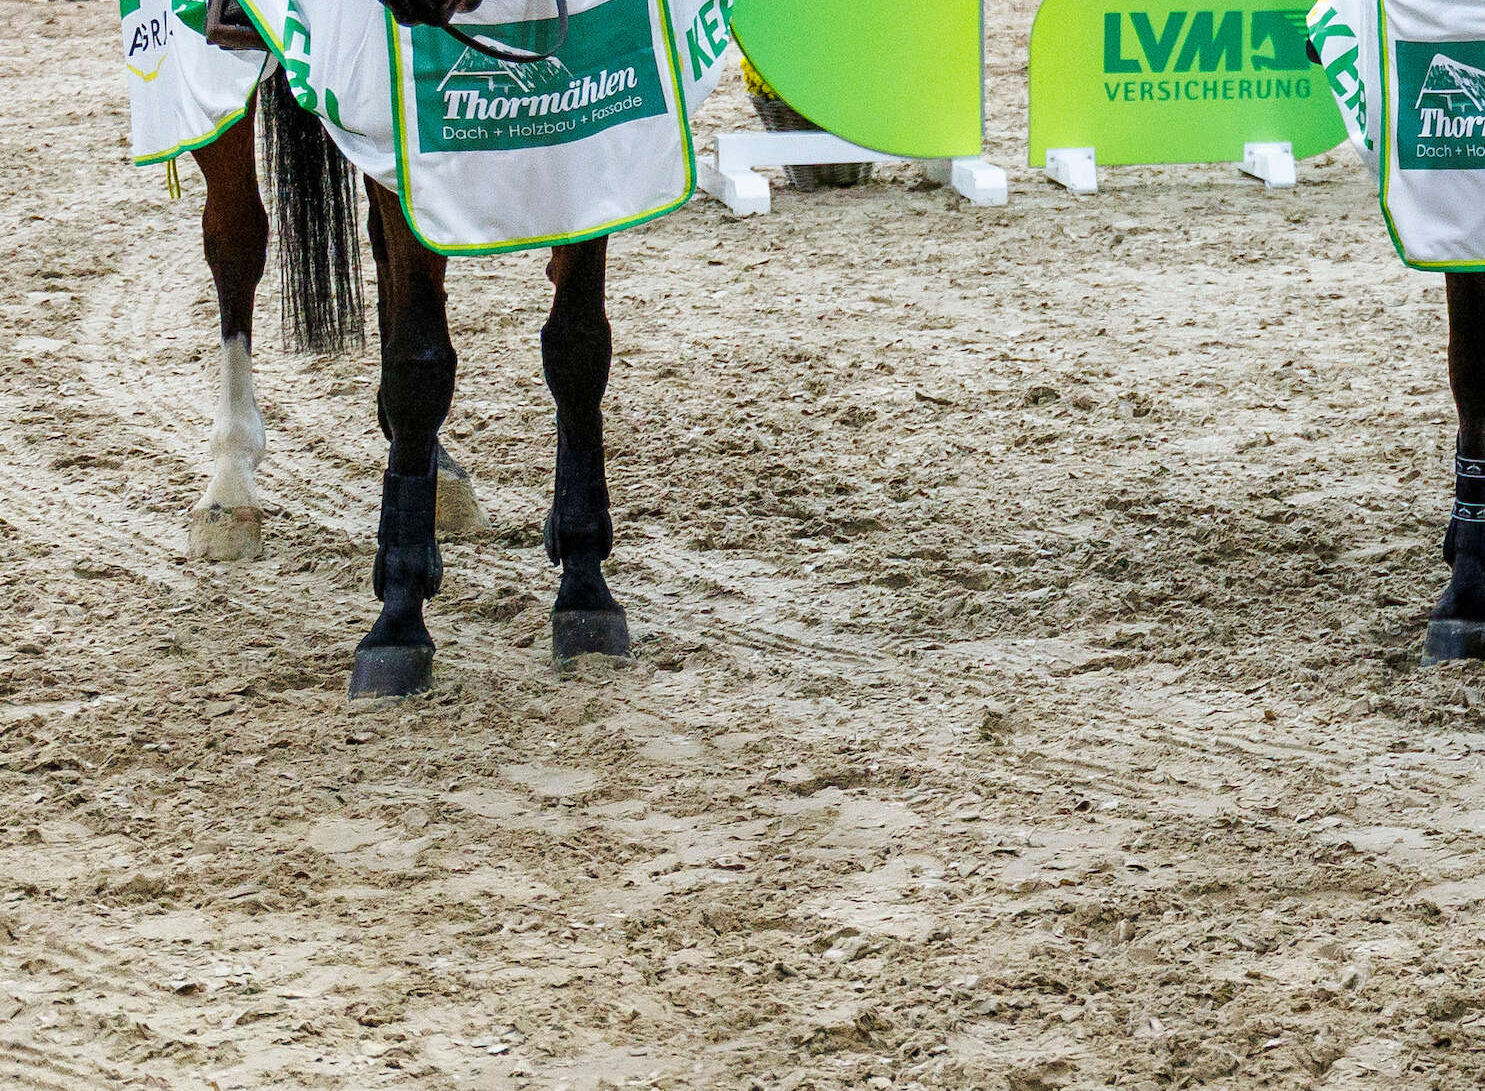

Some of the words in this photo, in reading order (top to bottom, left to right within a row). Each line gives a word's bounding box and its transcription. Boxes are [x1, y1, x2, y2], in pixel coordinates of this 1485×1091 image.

[1103, 10, 1243, 74] LVM
[442, 66, 639, 120] Thormählen
[1103, 78, 1312, 102] VERSICHERUNG
[442, 126, 488, 140] Dach
[508, 119, 577, 138] Holzbau
[591, 96, 643, 121] Fassade
[1416, 143, 1451, 158] Dach
